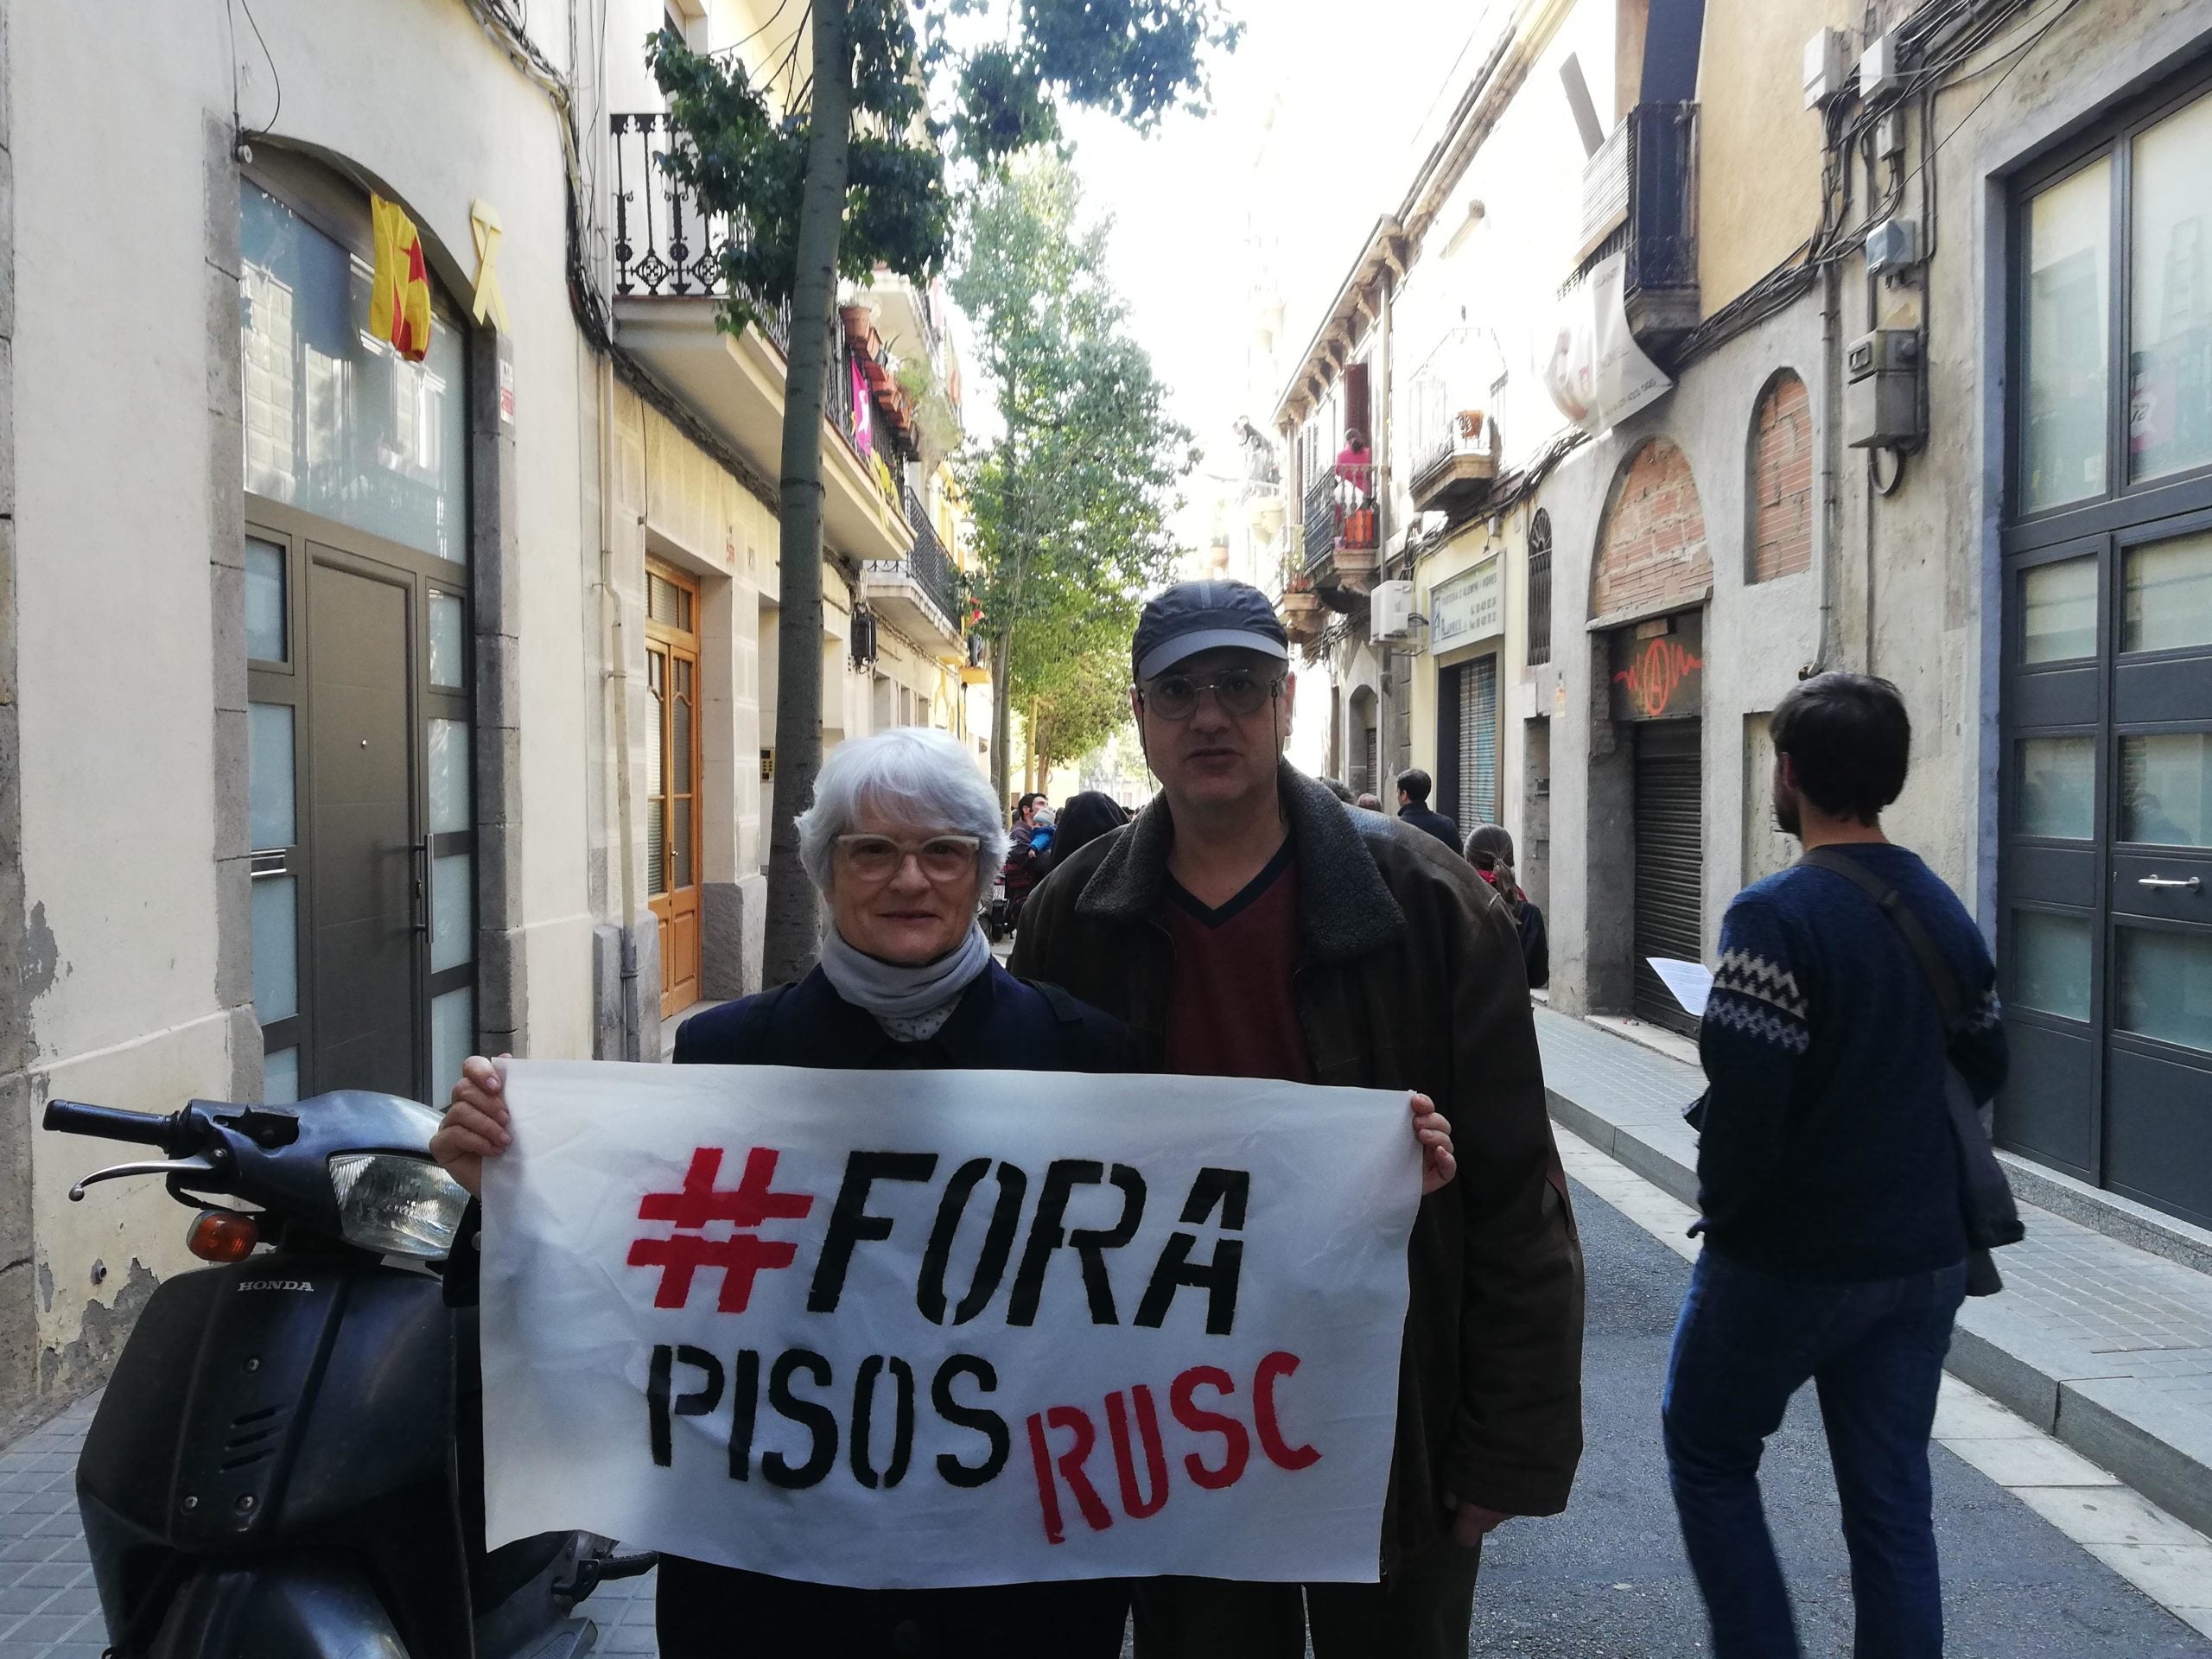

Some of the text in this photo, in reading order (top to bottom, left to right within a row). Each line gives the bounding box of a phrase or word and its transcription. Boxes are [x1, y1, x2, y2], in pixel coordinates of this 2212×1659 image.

[237, 1281, 315, 1292] HONDA
[627, 1147, 1249, 1335] #FORA
[647, 1345, 1321, 1545] PISOS RUSC
